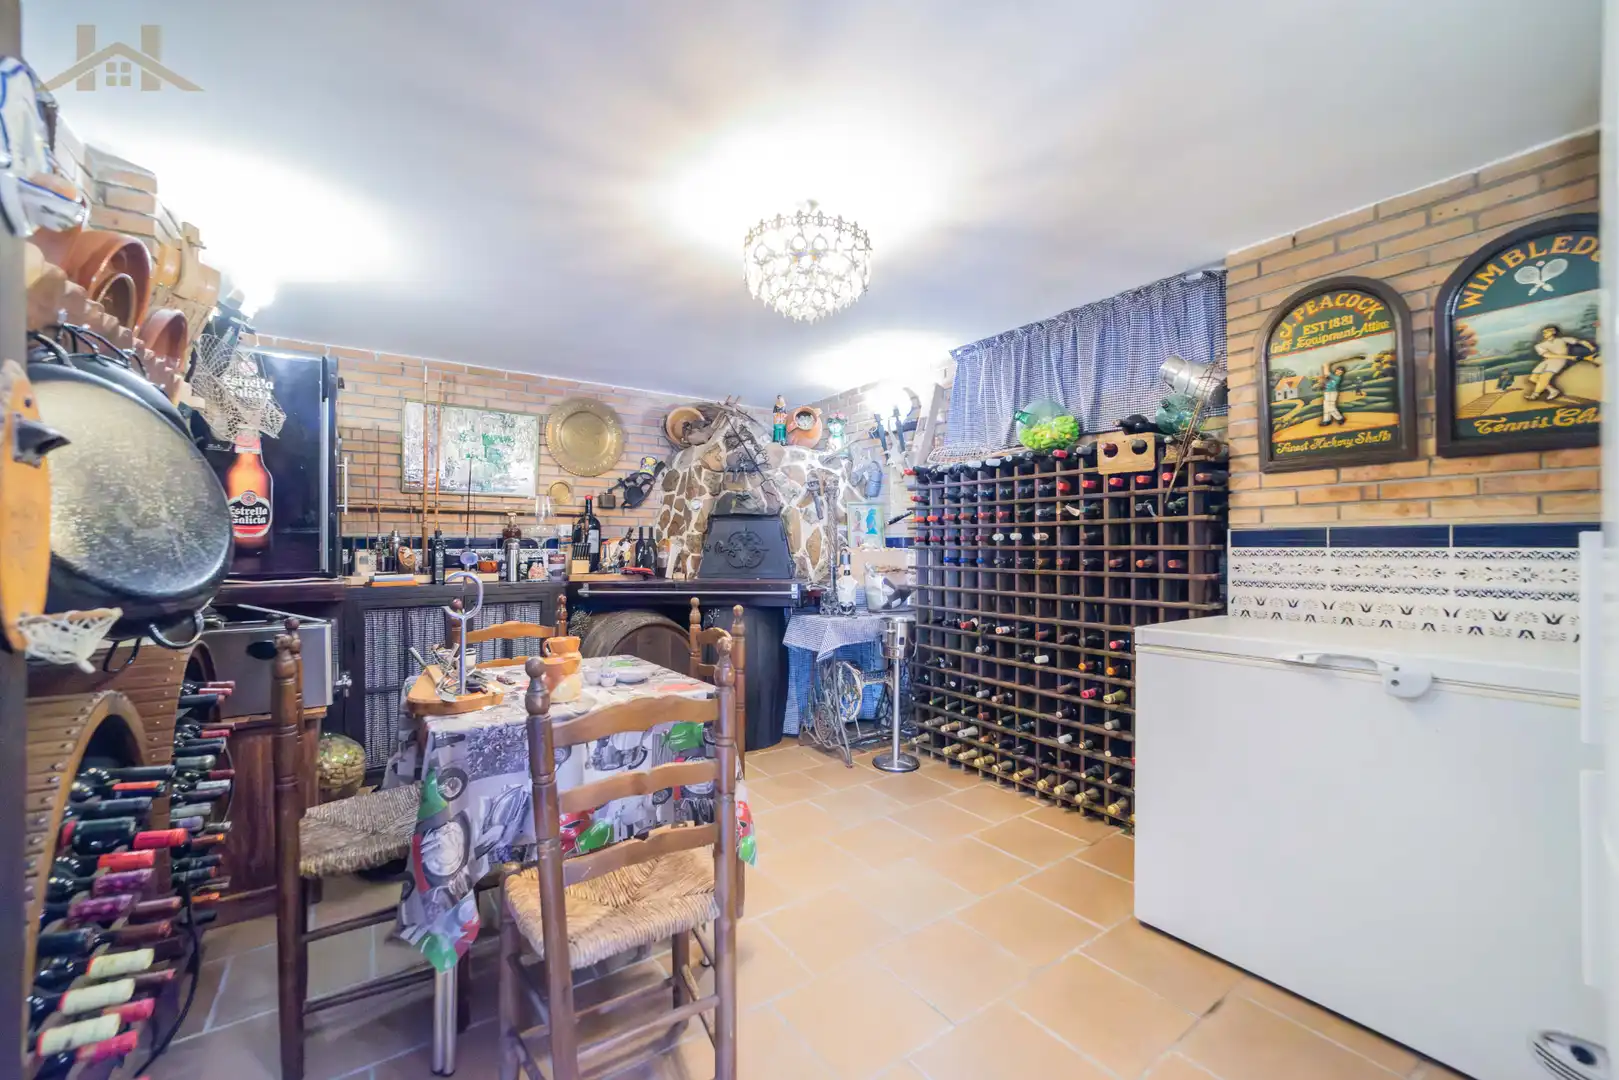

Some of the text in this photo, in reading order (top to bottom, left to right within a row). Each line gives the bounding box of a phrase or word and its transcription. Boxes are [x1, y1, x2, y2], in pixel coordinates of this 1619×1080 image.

[1458, 236, 1601, 310] WIMBLED
[1292, 293, 1385, 323] PEACOCK
[1303, 320, 1328, 335] EST
[1473, 416, 1552, 435] Tennis
